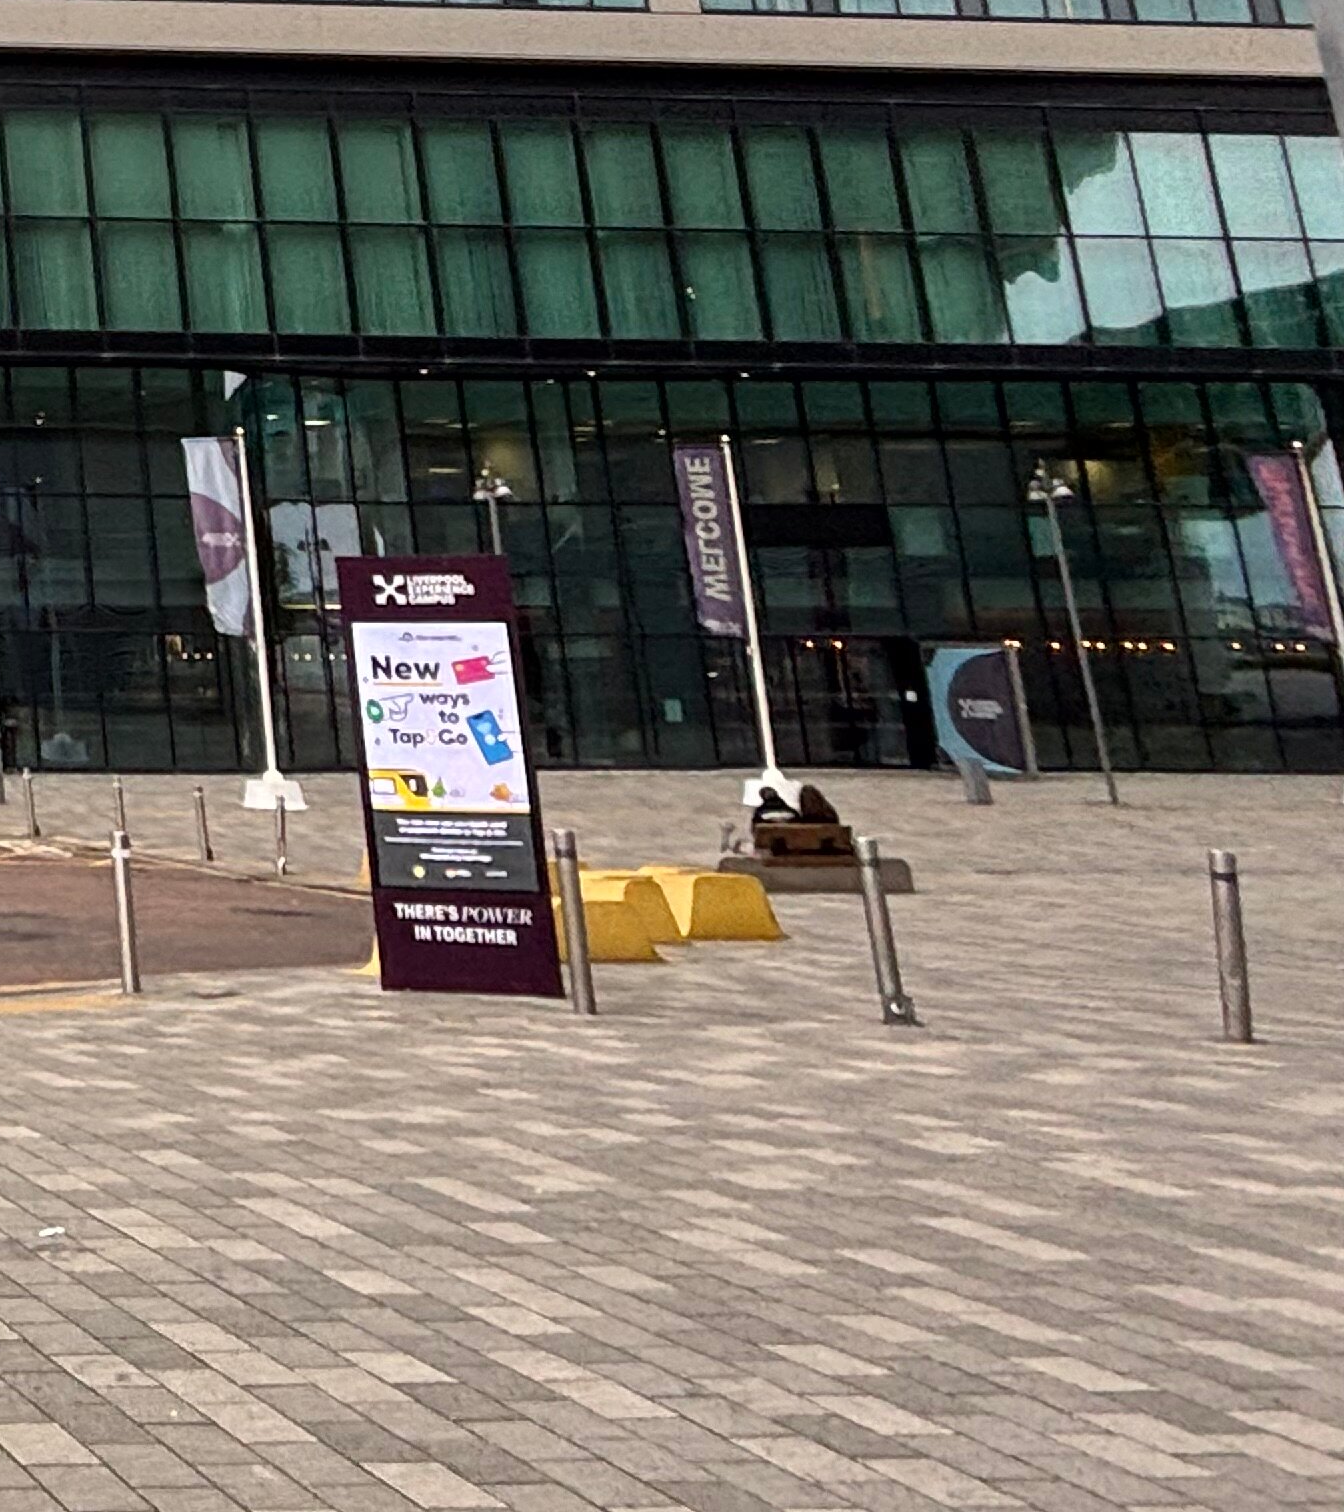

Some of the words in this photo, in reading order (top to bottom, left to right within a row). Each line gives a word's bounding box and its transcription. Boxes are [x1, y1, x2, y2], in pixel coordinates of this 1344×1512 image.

[370, 654, 440, 680] New
[418, 693, 470, 709] ways
[438, 710, 460, 724] to
[388, 728, 425, 748] Tap
[438, 729, 468, 745] Go
[393, 902, 460, 922] THERE'S
[461, 905, 534, 926] POWER
[414, 924, 432, 941] IN
[433, 925, 518, 946] TOGETHER
